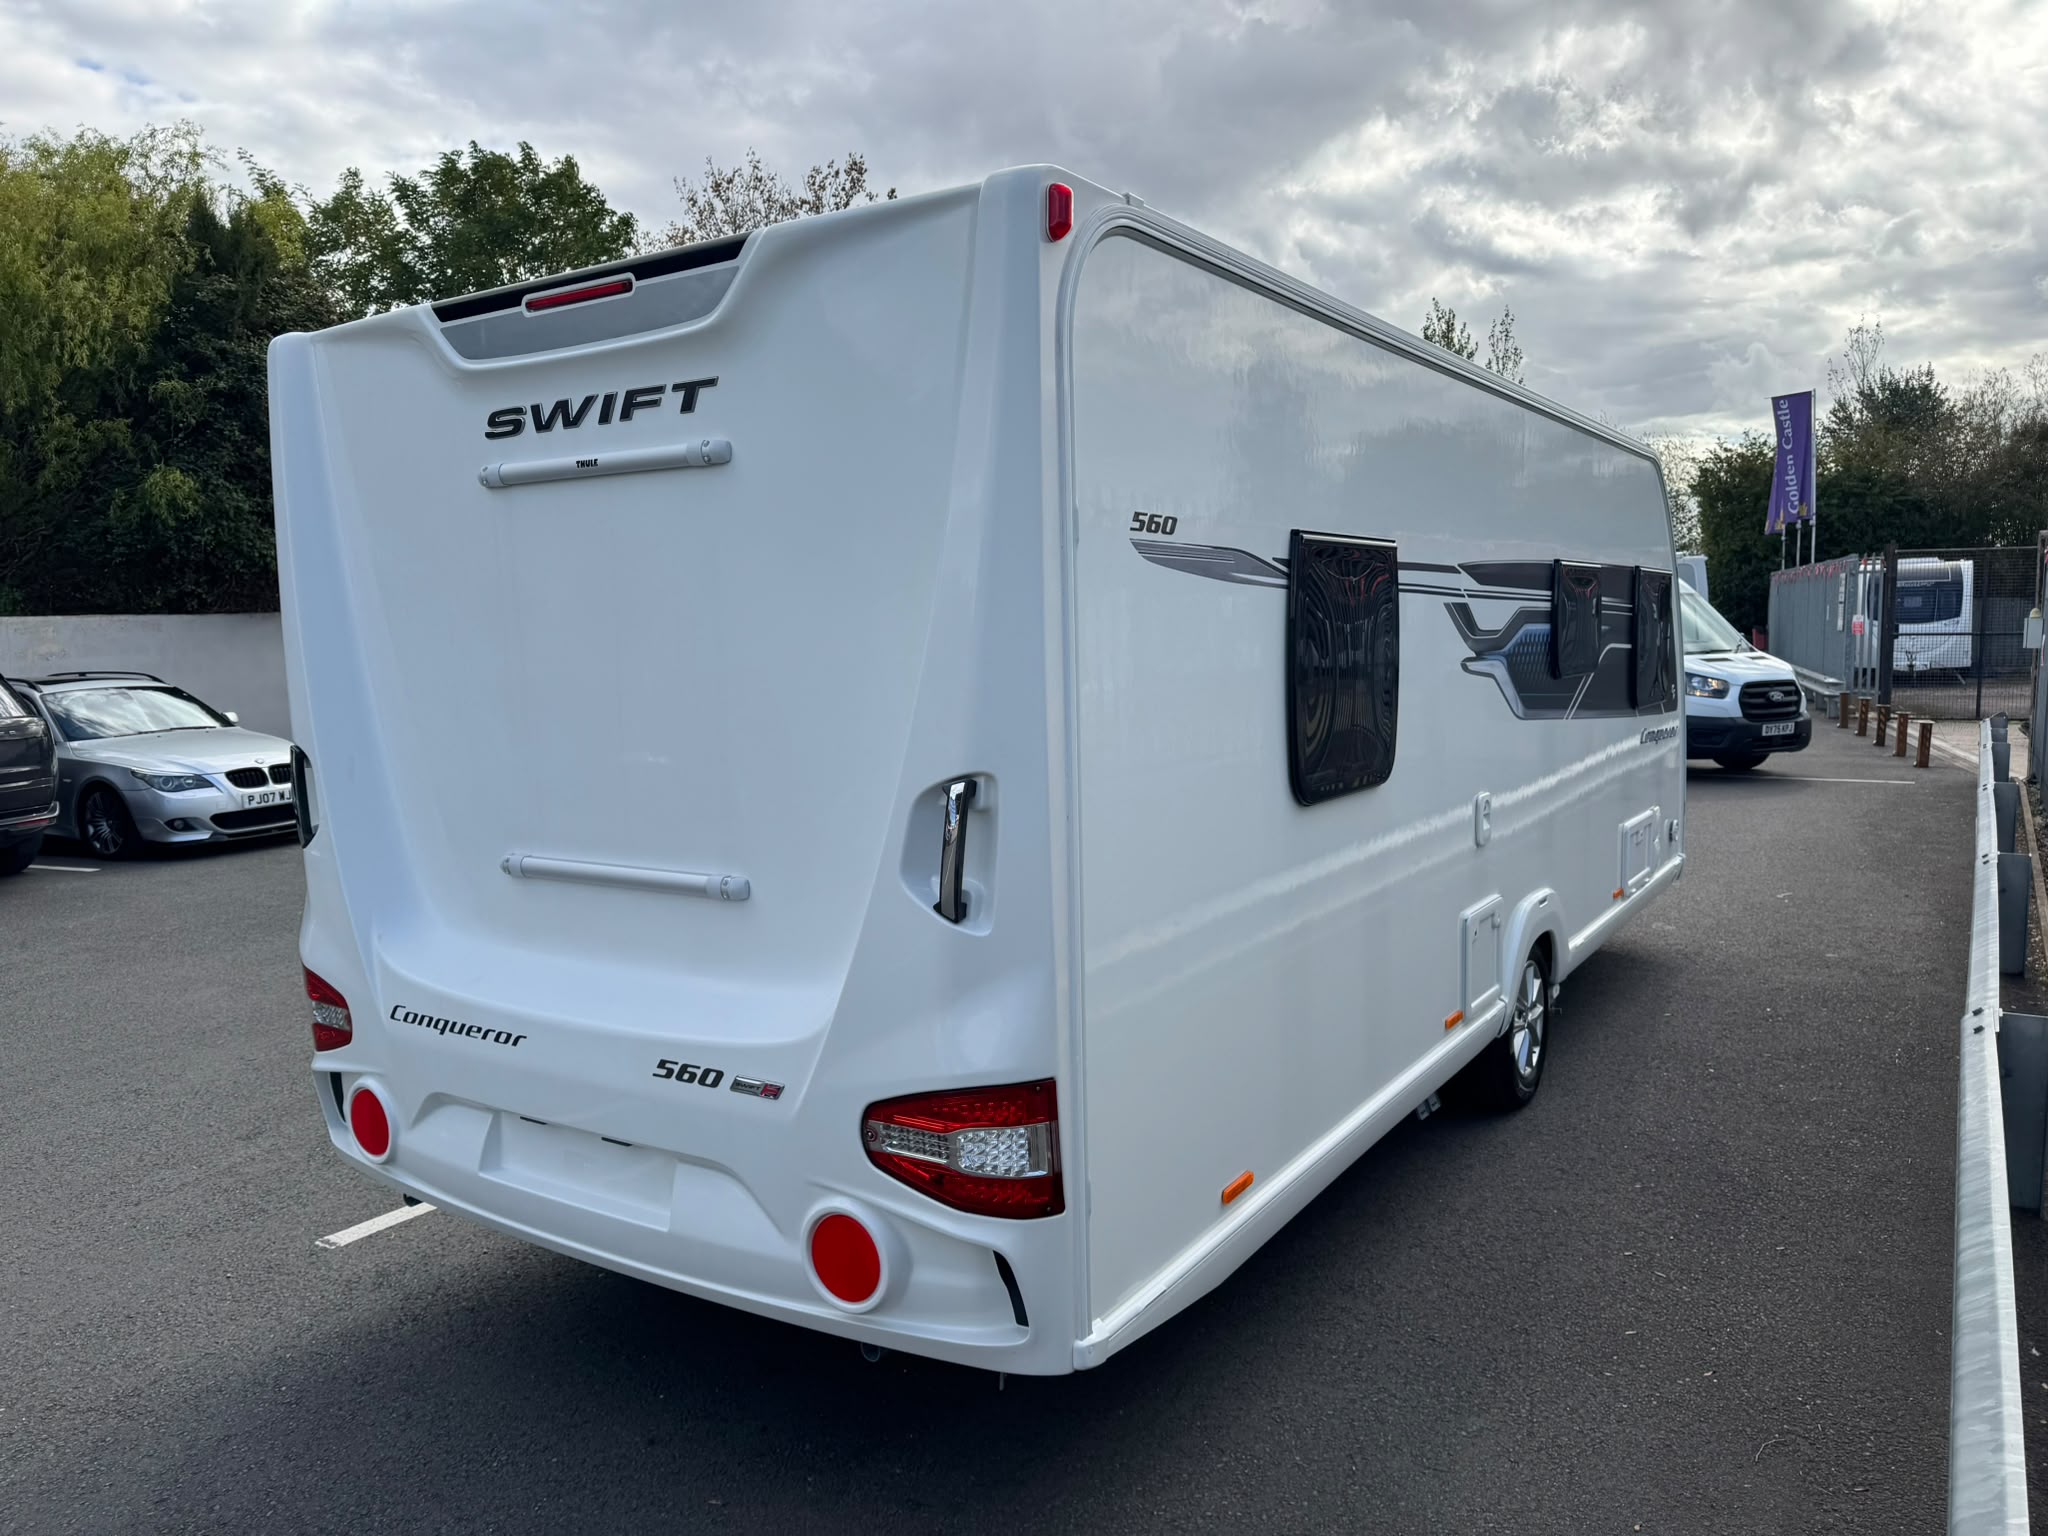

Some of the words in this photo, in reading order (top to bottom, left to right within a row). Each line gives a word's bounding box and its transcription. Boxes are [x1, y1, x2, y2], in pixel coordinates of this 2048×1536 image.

[485, 376, 719, 440] SWIFT
[1777, 399, 1793, 450] Castle
[576, 458, 599, 469] THULE
[1785, 454, 1799, 514] Golden
[1129, 511, 1178, 536] 560
[247, 792, 276, 805] PJ07
[278, 790, 292, 801] WJ
[390, 1004, 527, 1047] Conqueror
[652, 1059, 725, 1088] 560
